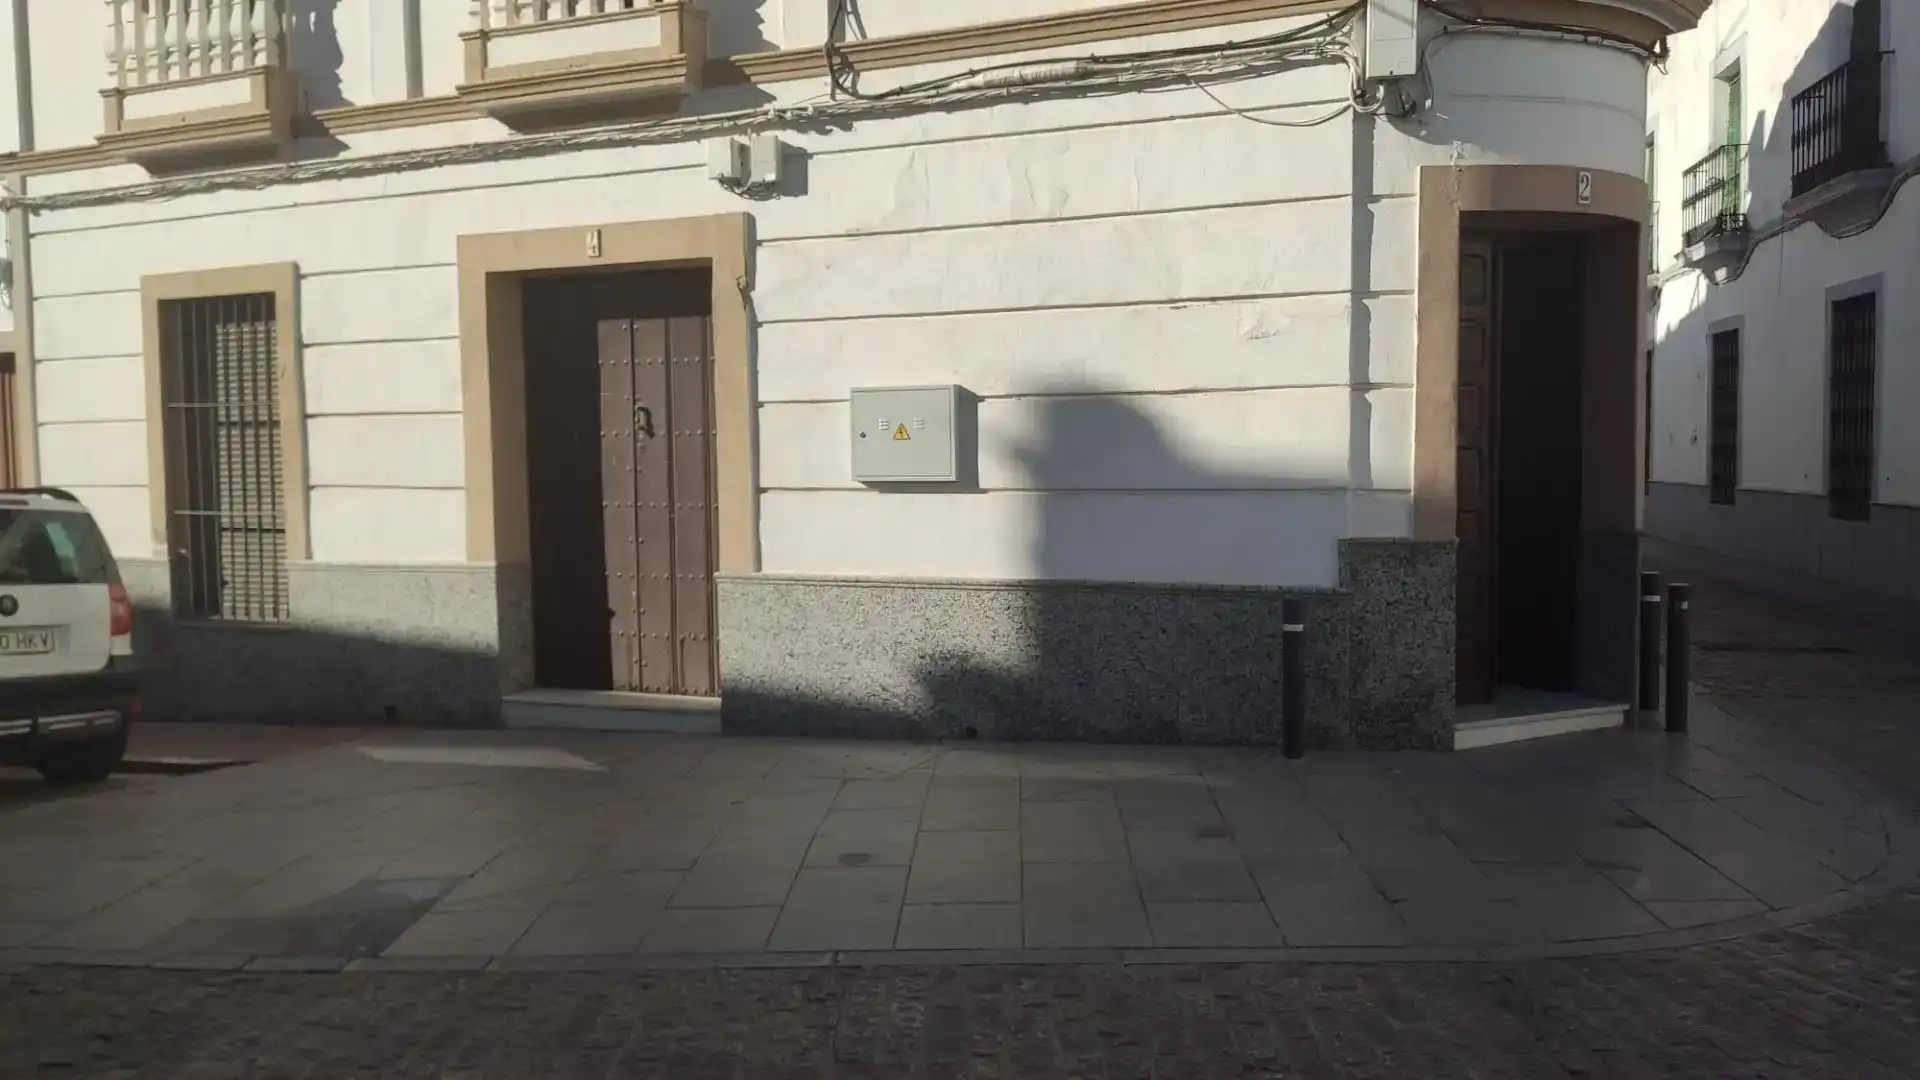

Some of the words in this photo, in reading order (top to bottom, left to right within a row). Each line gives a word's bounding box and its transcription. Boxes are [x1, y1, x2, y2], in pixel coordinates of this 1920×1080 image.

[1580, 174, 1590, 201] 2
[588, 230, 597, 254] 4
[16, 630, 49, 650] HKV
